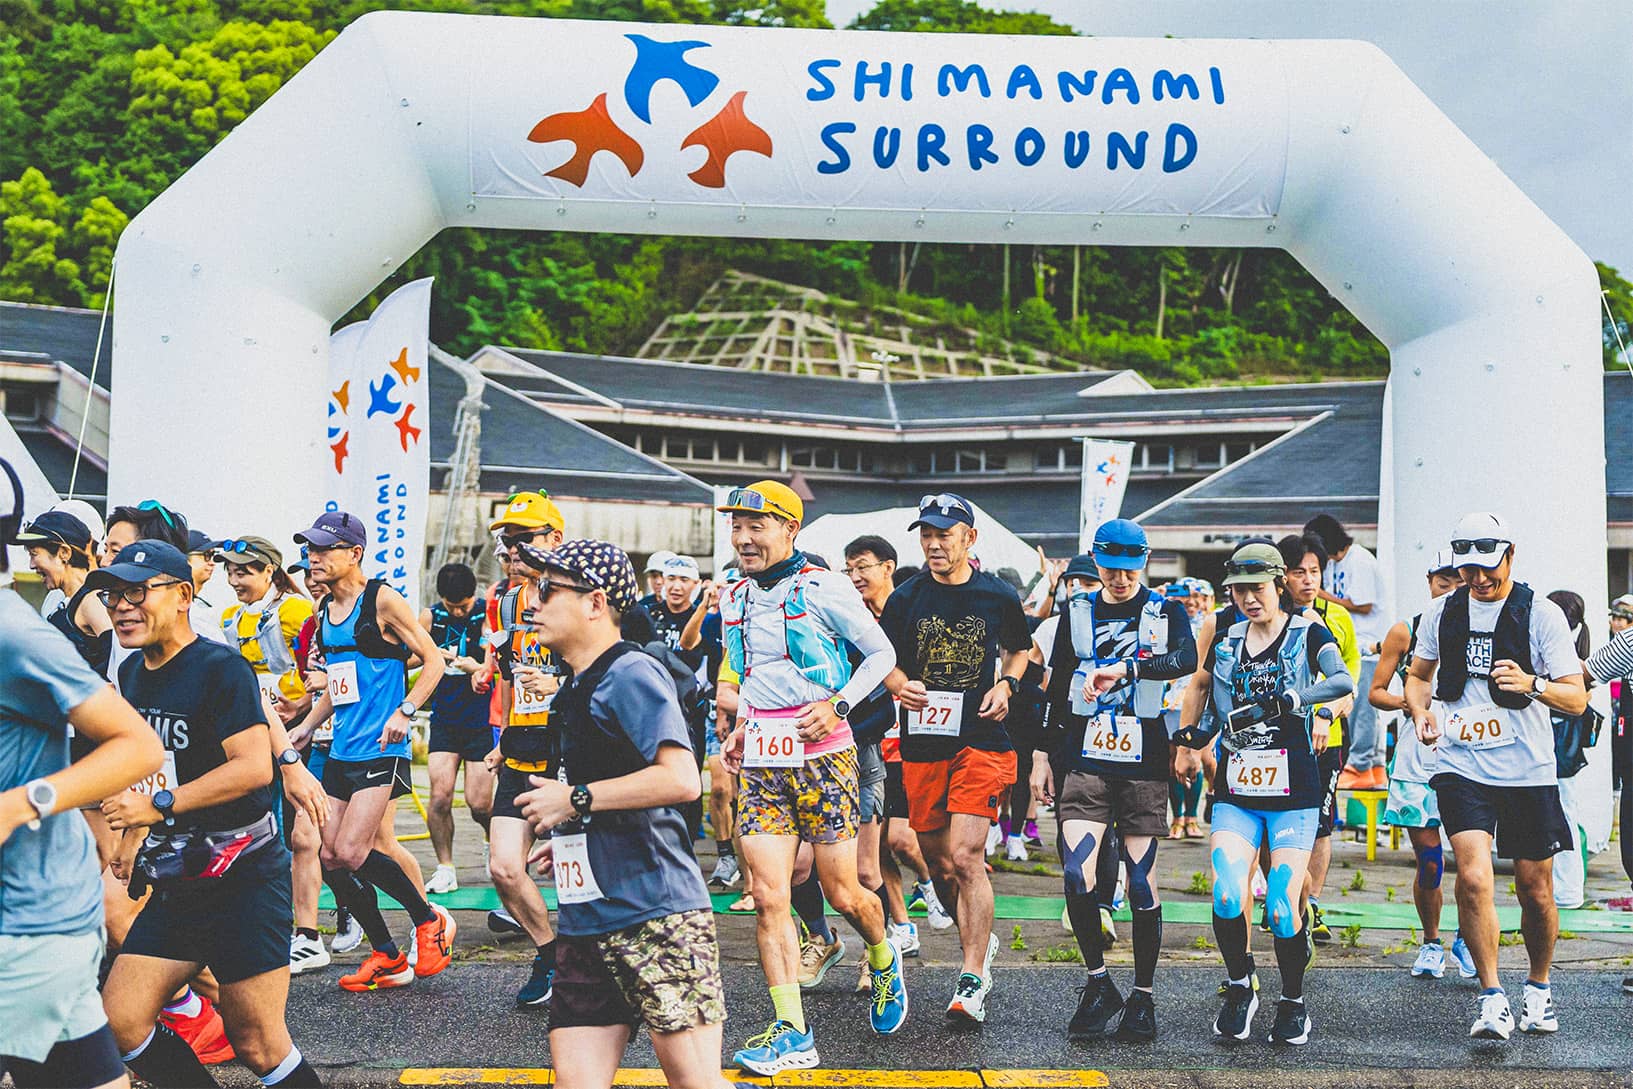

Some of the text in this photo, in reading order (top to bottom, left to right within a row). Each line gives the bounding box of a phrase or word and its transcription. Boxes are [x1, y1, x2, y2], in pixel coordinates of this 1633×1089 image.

[806, 58, 1226, 105] SHIMANAMI
[816, 121, 1199, 174] SURROUND
[918, 706, 952, 725] 127
[1093, 730, 1132, 752] 486
[1459, 719, 1501, 742] 490
[756, 736, 793, 756] 160
[1237, 767, 1278, 786] 487
